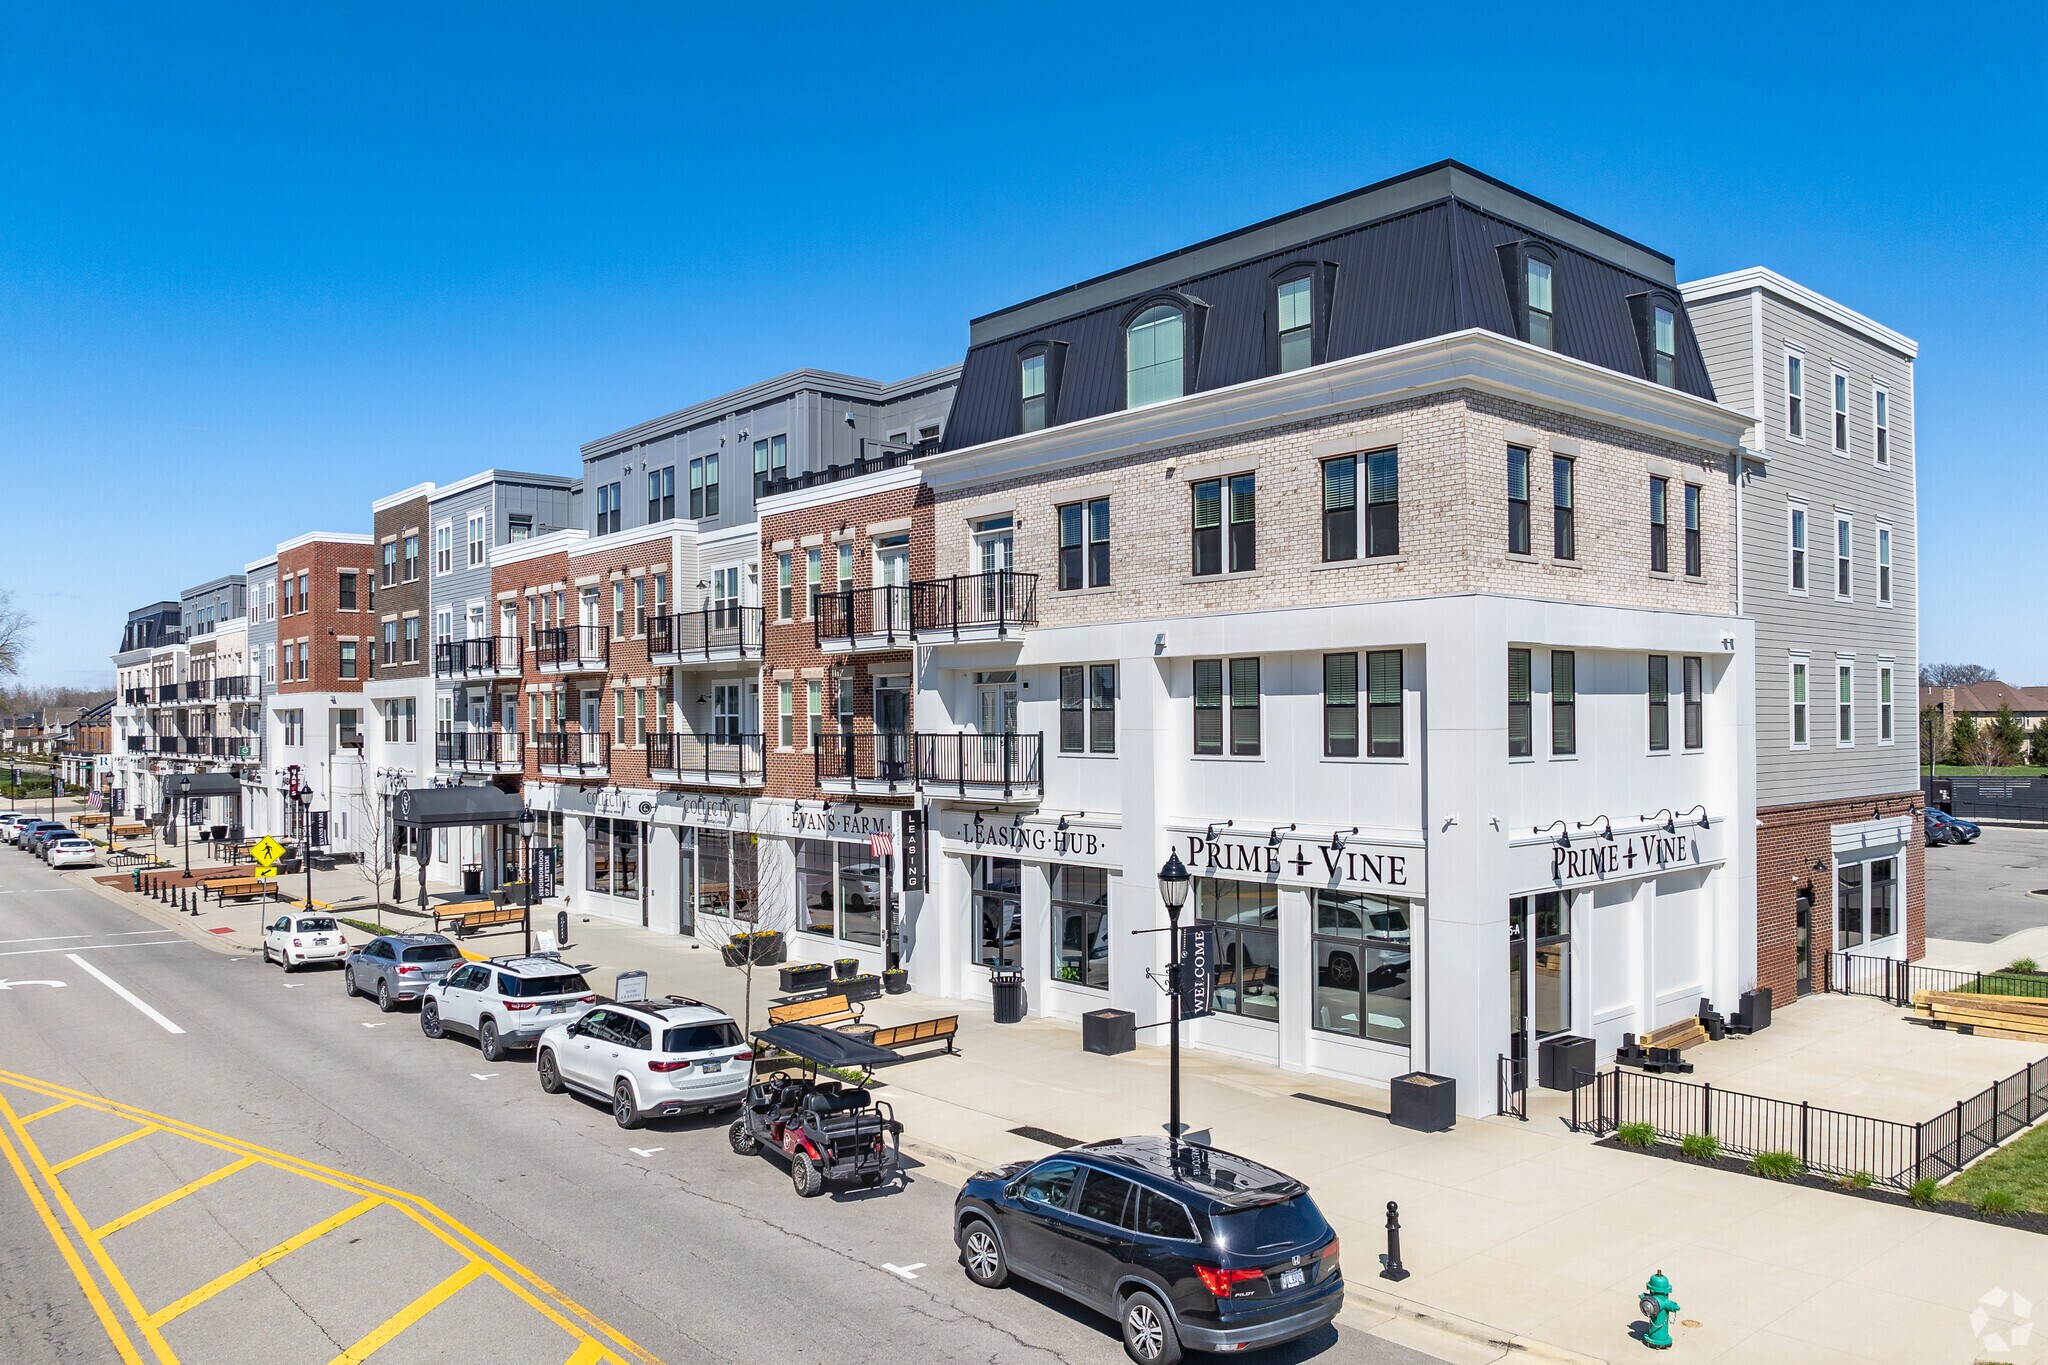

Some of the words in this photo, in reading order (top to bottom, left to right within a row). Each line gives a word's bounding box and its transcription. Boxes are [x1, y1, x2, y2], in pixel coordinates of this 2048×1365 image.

[586, 792, 631, 808] COLLECTIVE
[683, 799, 739, 818] COLLECTIVE
[791, 810, 836, 832] EVANS
[843, 817, 885, 834] FARM
[908, 815, 917, 886] LEASING
[963, 823, 1045, 850] LEASING
[1053, 831, 1097, 855] HUB
[1187, 836, 1281, 874] PRIME
[1318, 845, 1408, 886] VINE
[1552, 844, 1619, 881] PRIME
[1640, 835, 1687, 866] VINE
[544, 888, 550, 896] OF
[1194, 930, 1205, 1015] WELCOME
